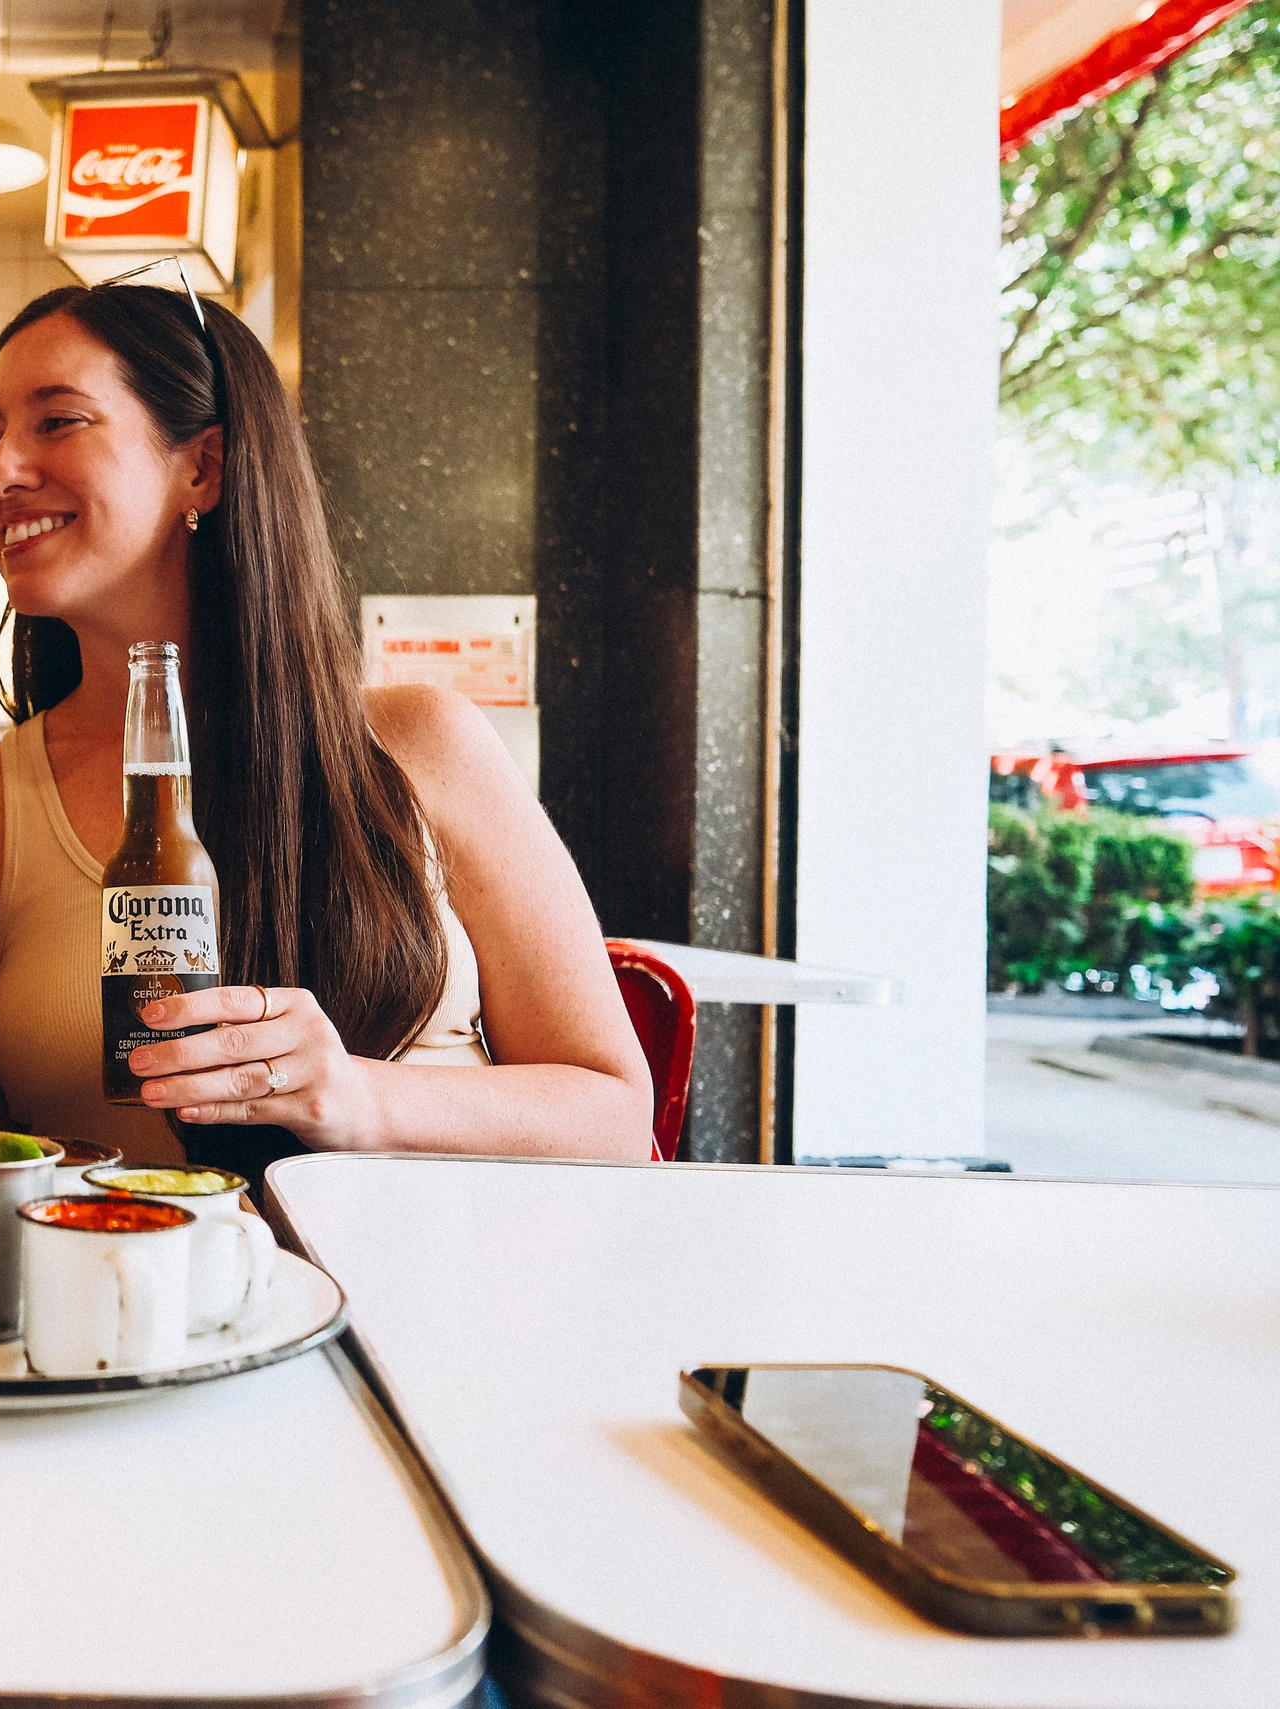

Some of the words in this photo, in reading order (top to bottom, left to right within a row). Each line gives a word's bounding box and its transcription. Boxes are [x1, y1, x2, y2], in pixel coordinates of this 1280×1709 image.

[108, 890, 205, 927] Corona
[130, 920, 188, 941] Extra
[148, 981, 162, 989] LA
[133, 989, 179, 999] CERVEZA
[129, 1031, 150, 1039] HECHO
